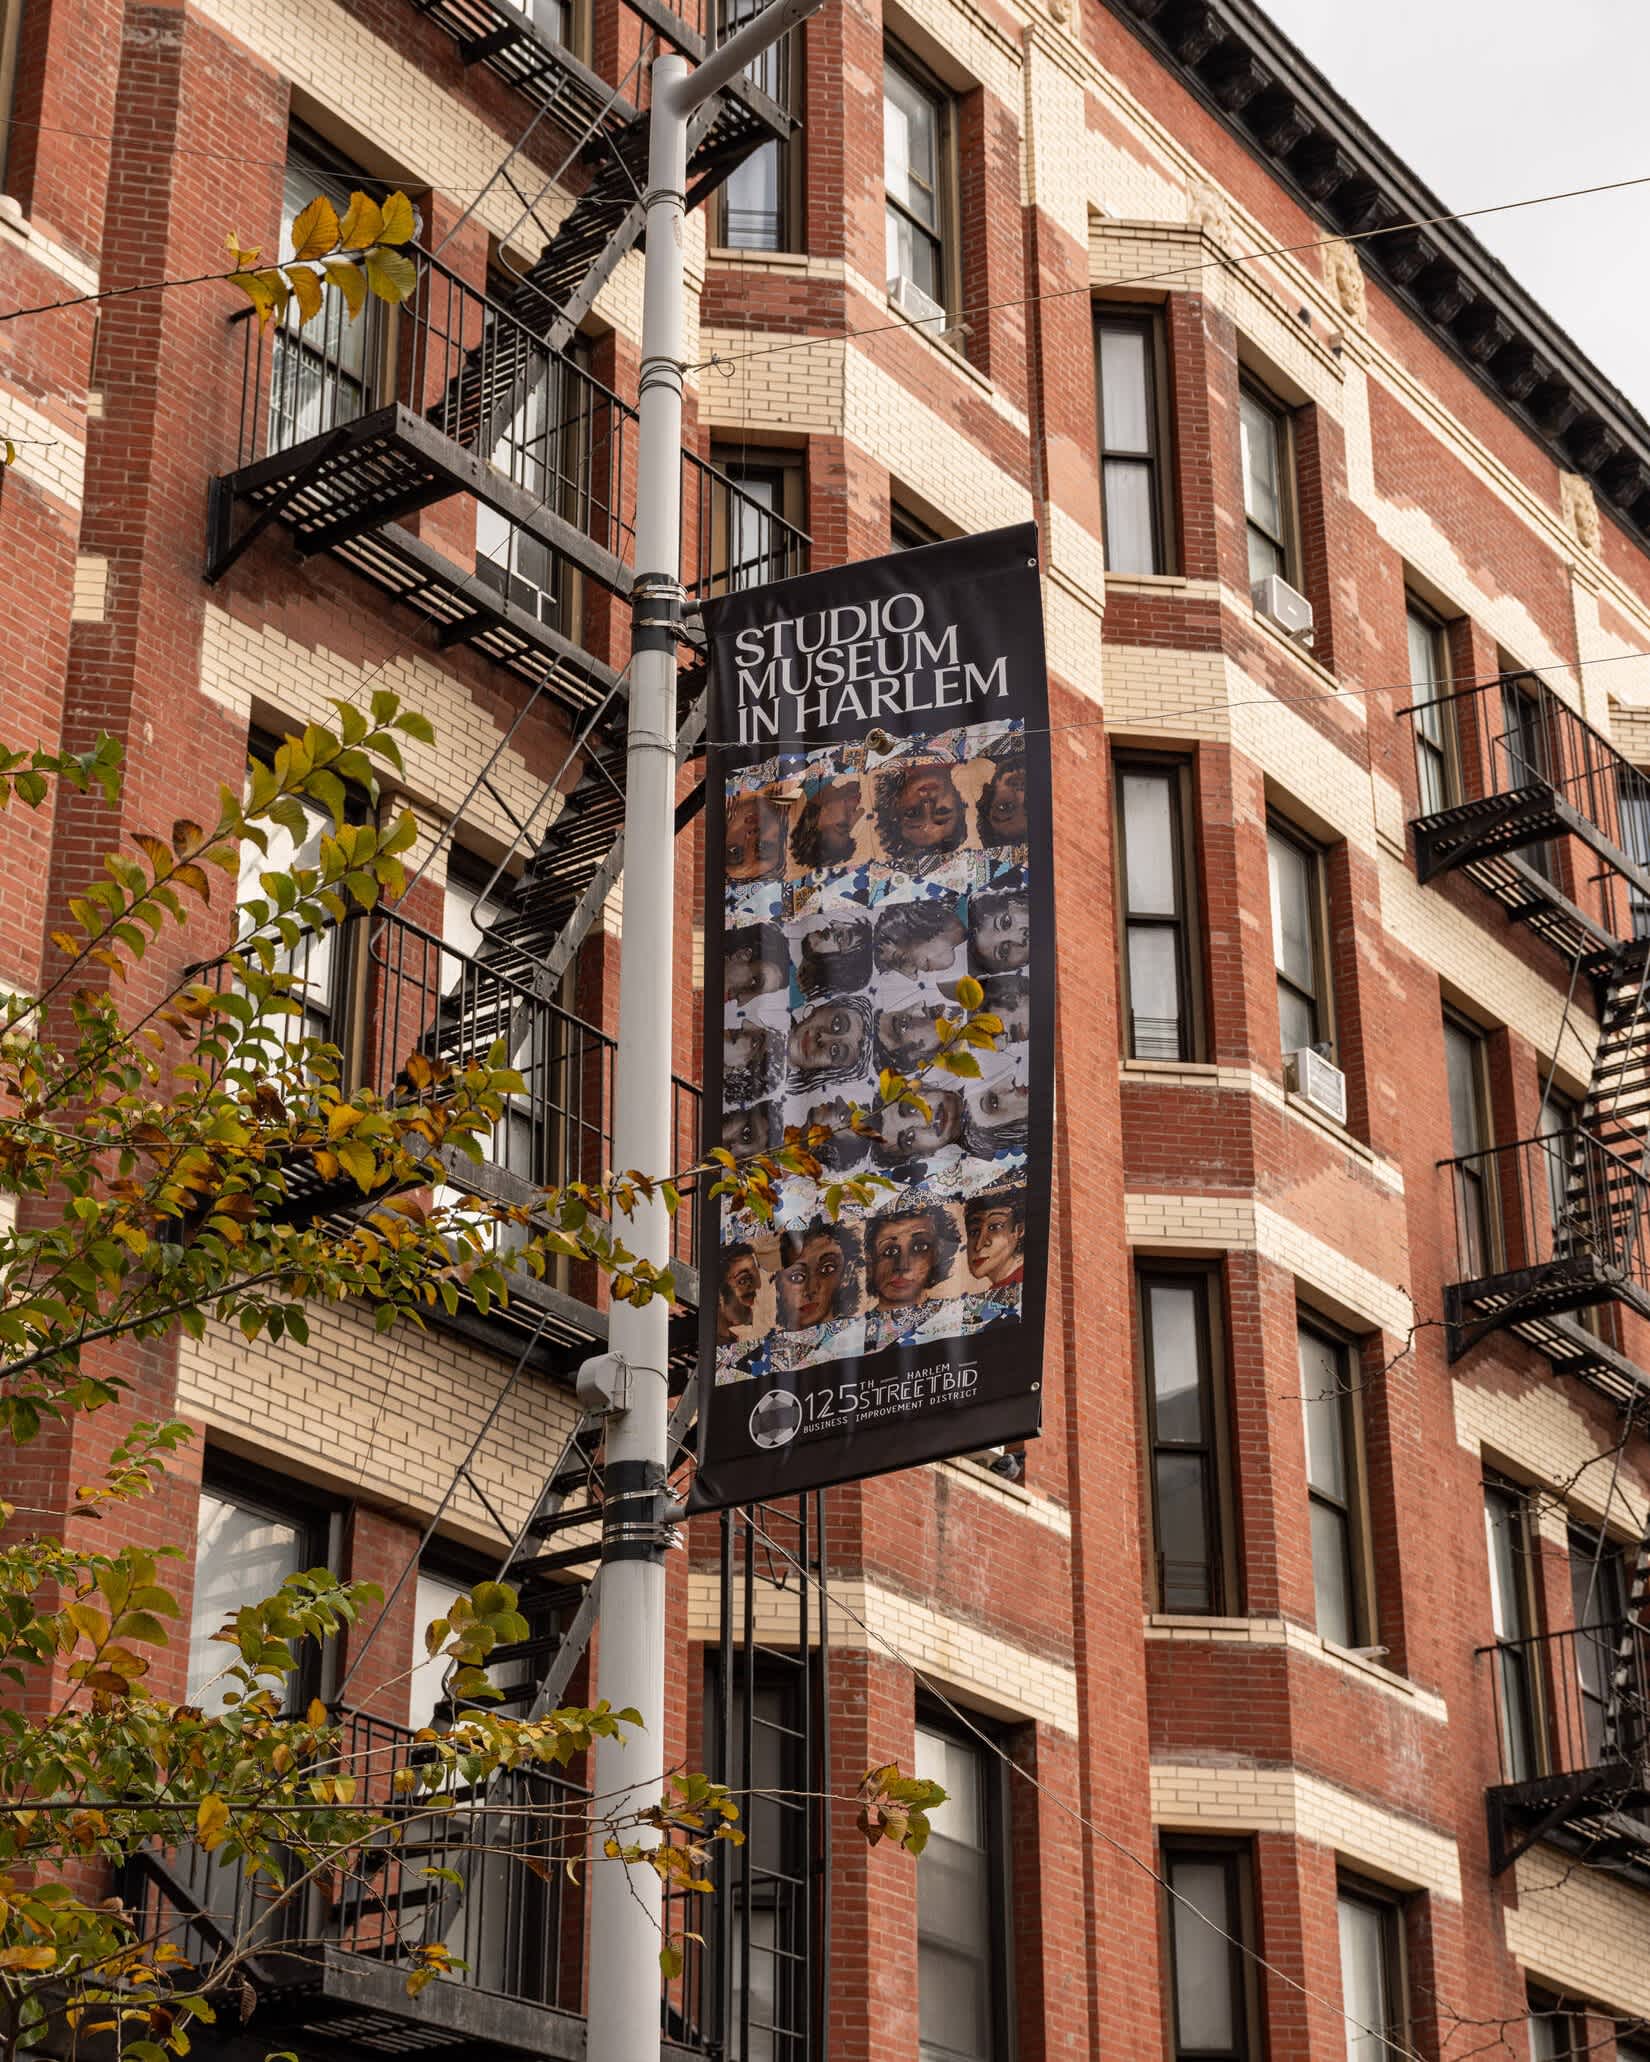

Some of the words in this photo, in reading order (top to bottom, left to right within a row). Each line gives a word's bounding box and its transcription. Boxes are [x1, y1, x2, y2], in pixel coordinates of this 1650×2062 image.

[735, 592, 925, 667] STUDIO
[737, 624, 960, 708] MUSEUM
[737, 697, 781, 745] IN
[795, 656, 1009, 733] HARLEM
[906, 1362, 951, 1381] HARLEM
[803, 1416, 849, 1434] BUSINESS
[855, 1399, 924, 1423] IMPROVEMENT
[929, 1387, 978, 1406] DISTRICT
